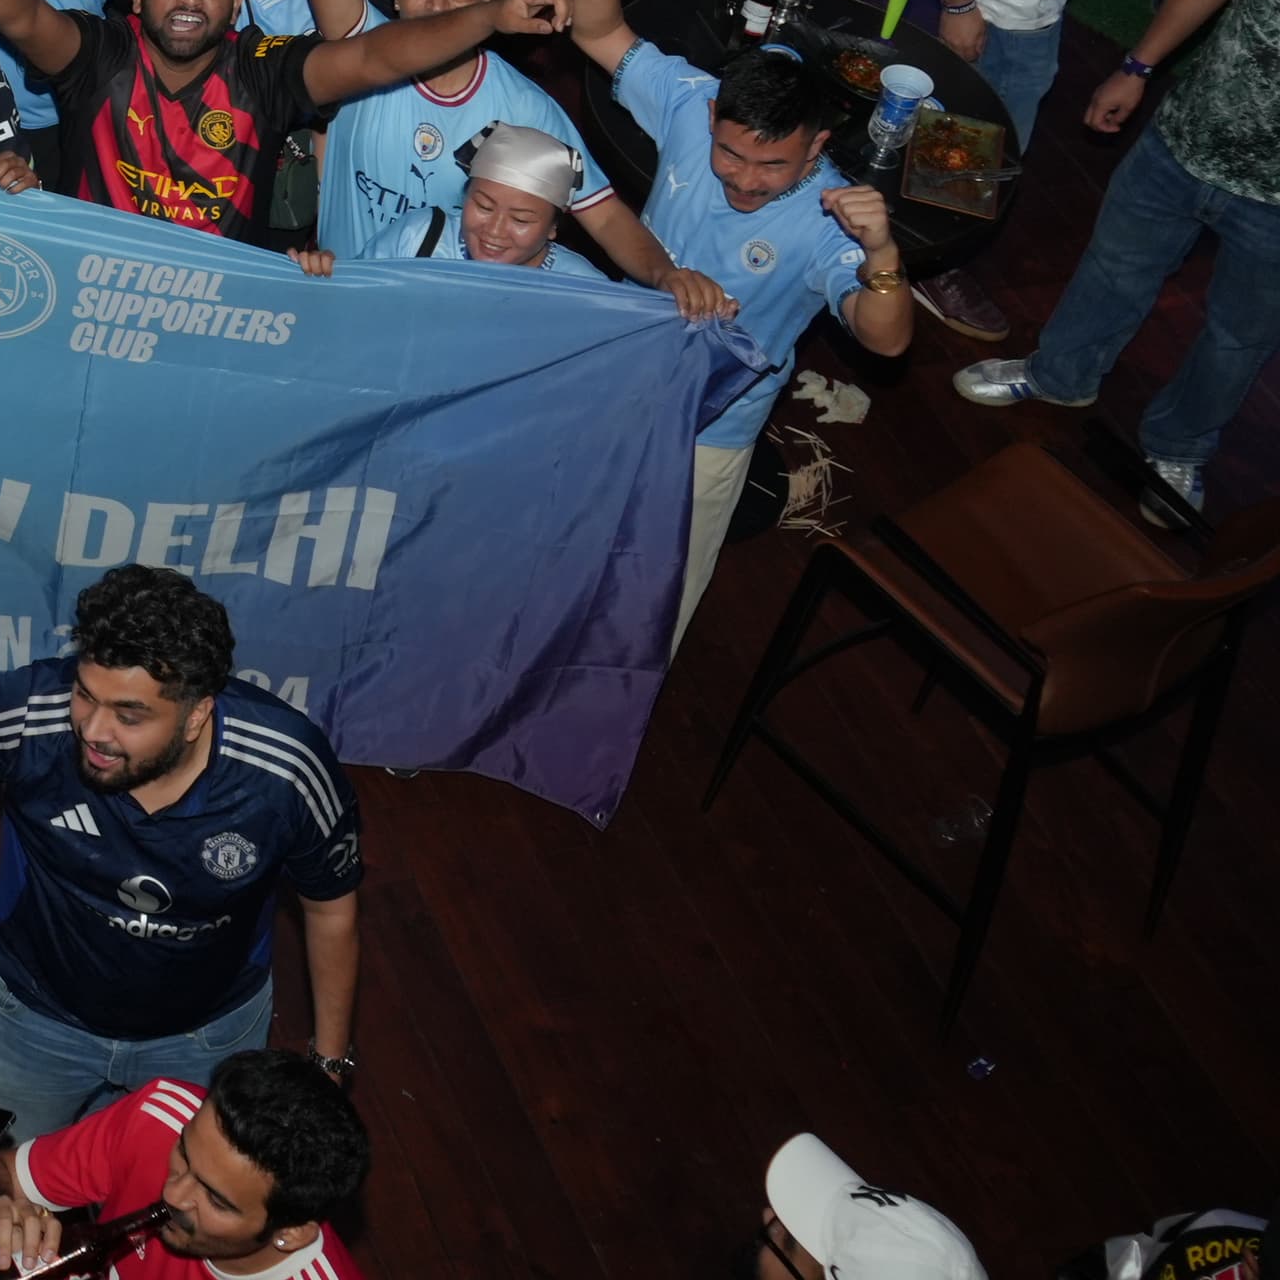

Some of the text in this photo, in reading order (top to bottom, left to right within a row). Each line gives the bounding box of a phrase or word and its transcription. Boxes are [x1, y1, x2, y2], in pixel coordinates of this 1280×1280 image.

[116, 160, 238, 200] ETIHAD
[76, 254, 225, 302] OFFICIAL
[71, 287, 297, 345] SUPPORTERS
[69, 323, 159, 365] CLUB
[55, 485, 394, 591] DELHI
